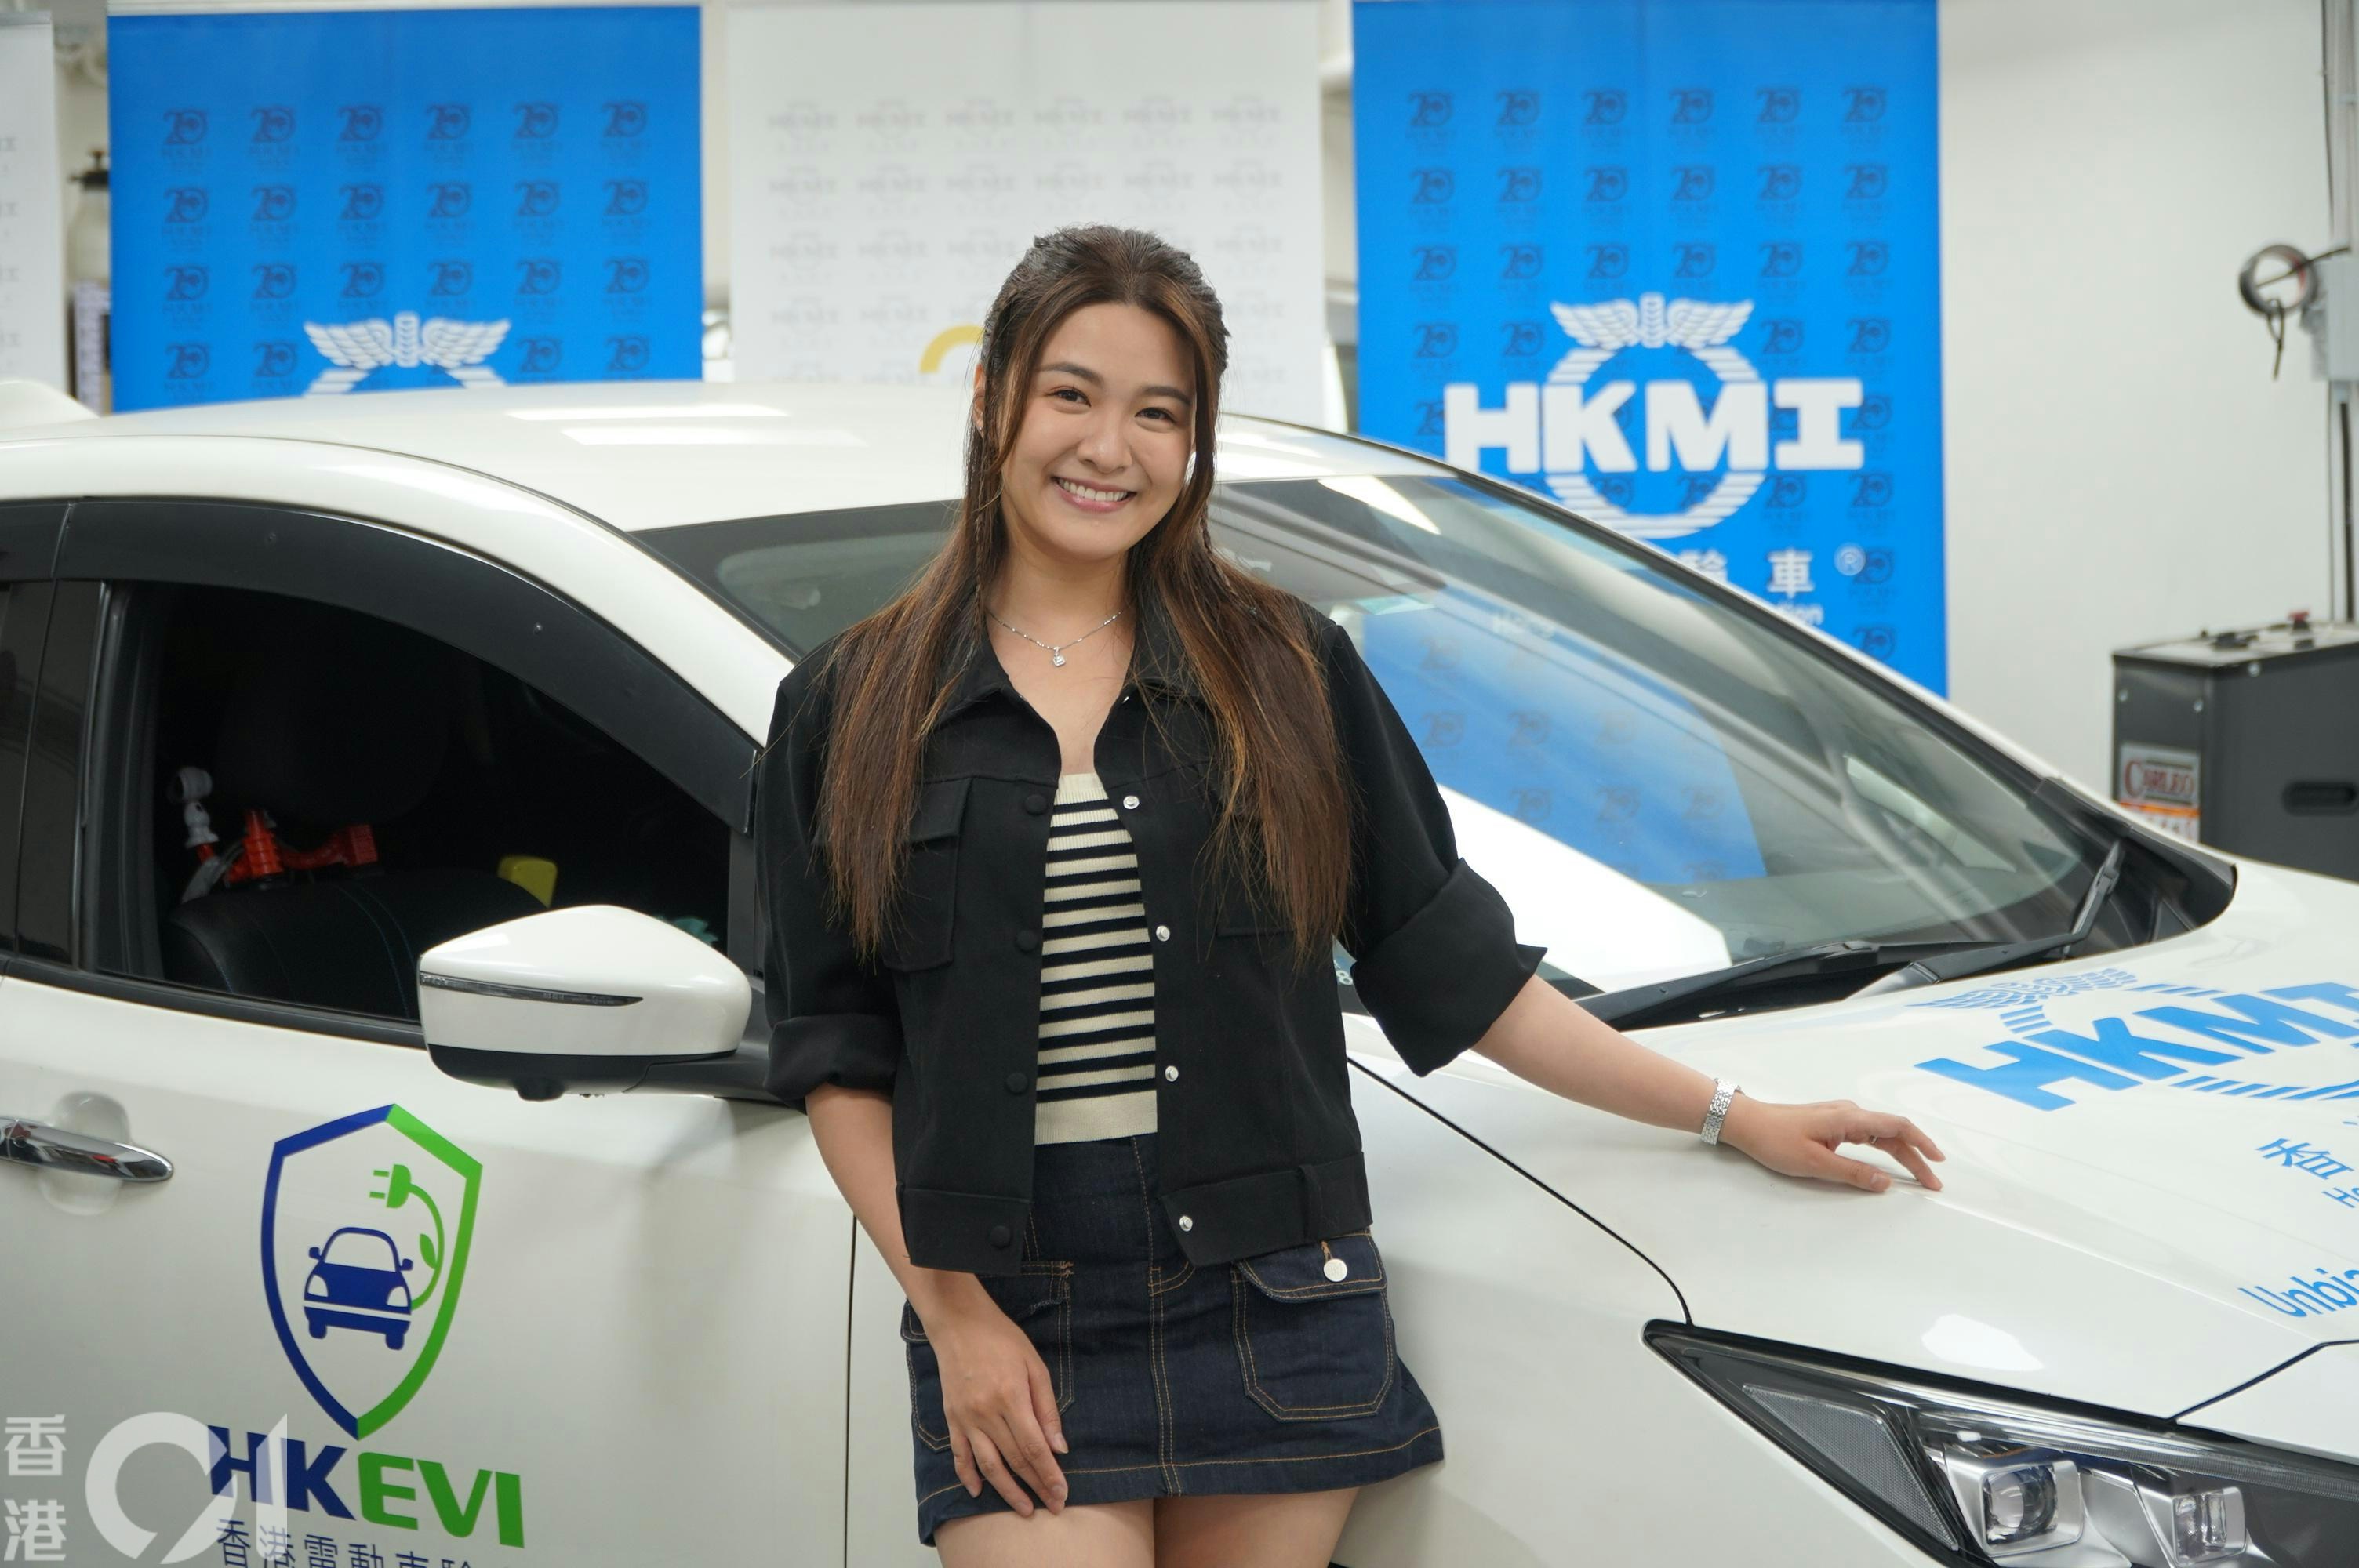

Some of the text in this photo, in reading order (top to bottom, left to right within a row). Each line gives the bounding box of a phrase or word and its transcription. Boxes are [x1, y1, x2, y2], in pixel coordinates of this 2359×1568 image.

[1445, 379, 1863, 472] HKMI
[1914, 982, 2359, 1112] HKMI
[2255, 1116, 2359, 1179] 香
[207, 1425, 525, 1548] HKEVI
[216, 1518, 474, 1568] 香港電動
